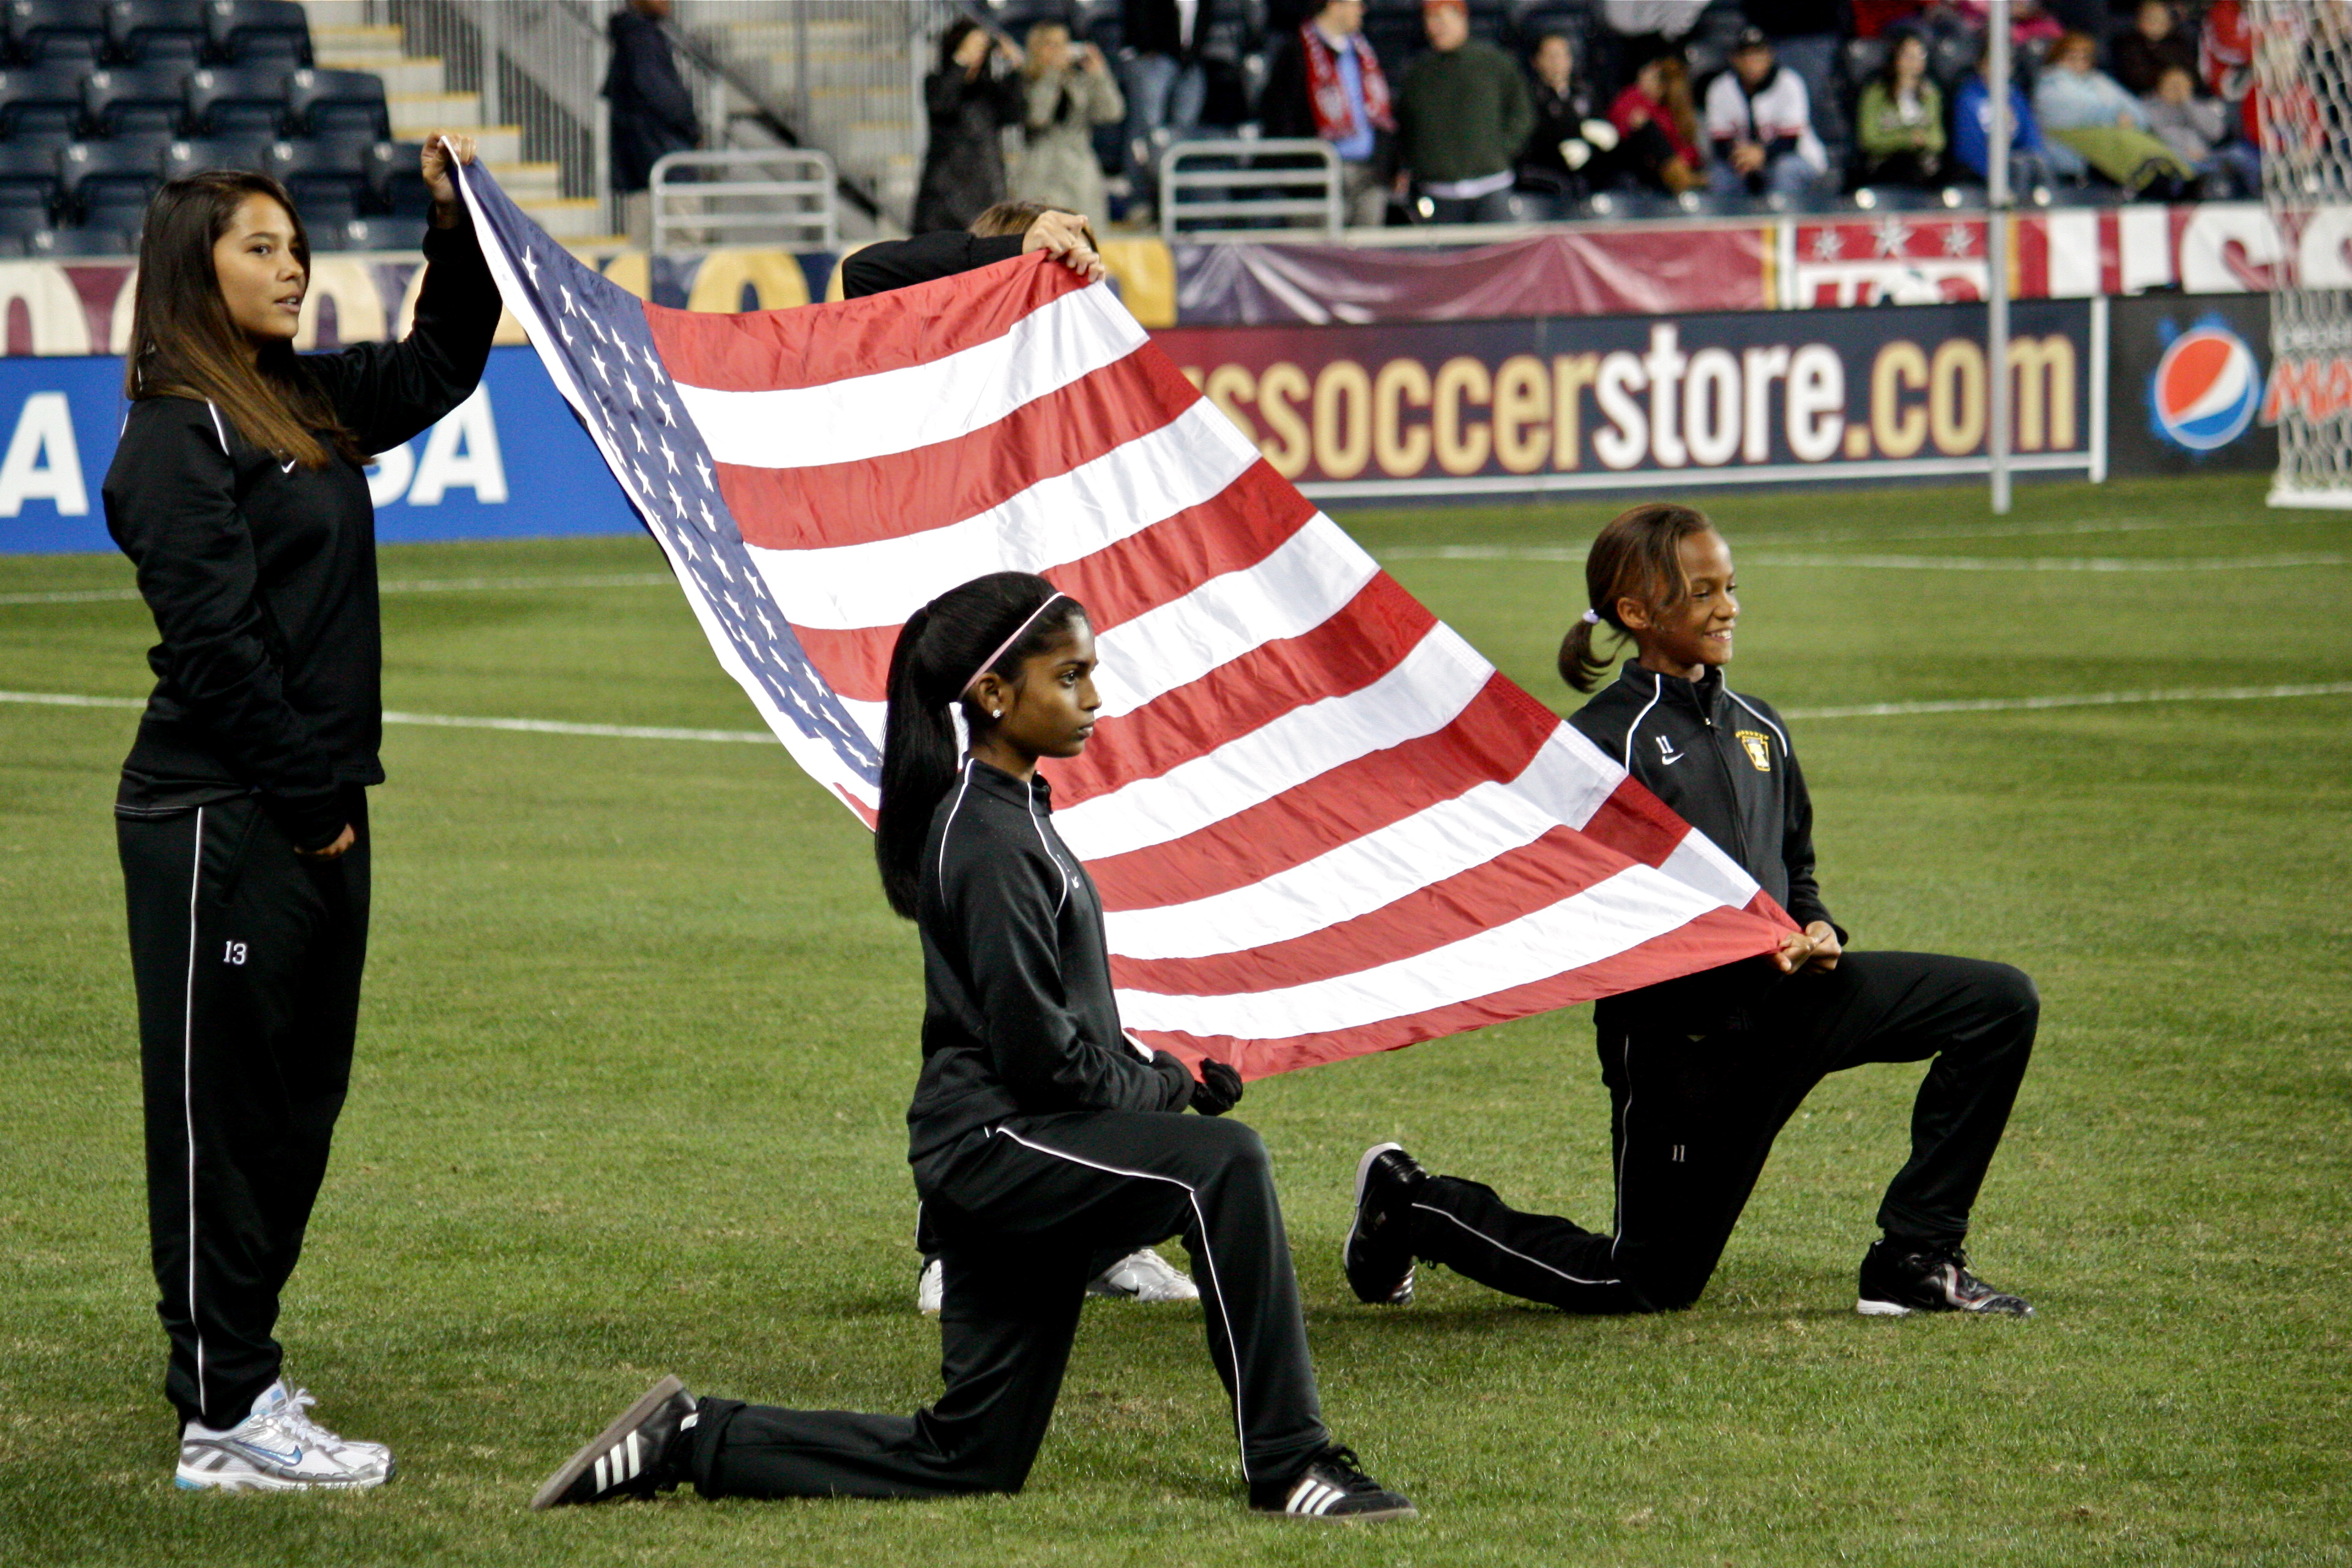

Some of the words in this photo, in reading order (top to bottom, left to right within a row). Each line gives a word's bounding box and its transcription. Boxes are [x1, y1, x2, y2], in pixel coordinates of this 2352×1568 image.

[1181, 322, 2077, 480] ssoccerstore.com
[223, 940, 247, 965] 13
[1672, 1145, 1685, 1162] 11
